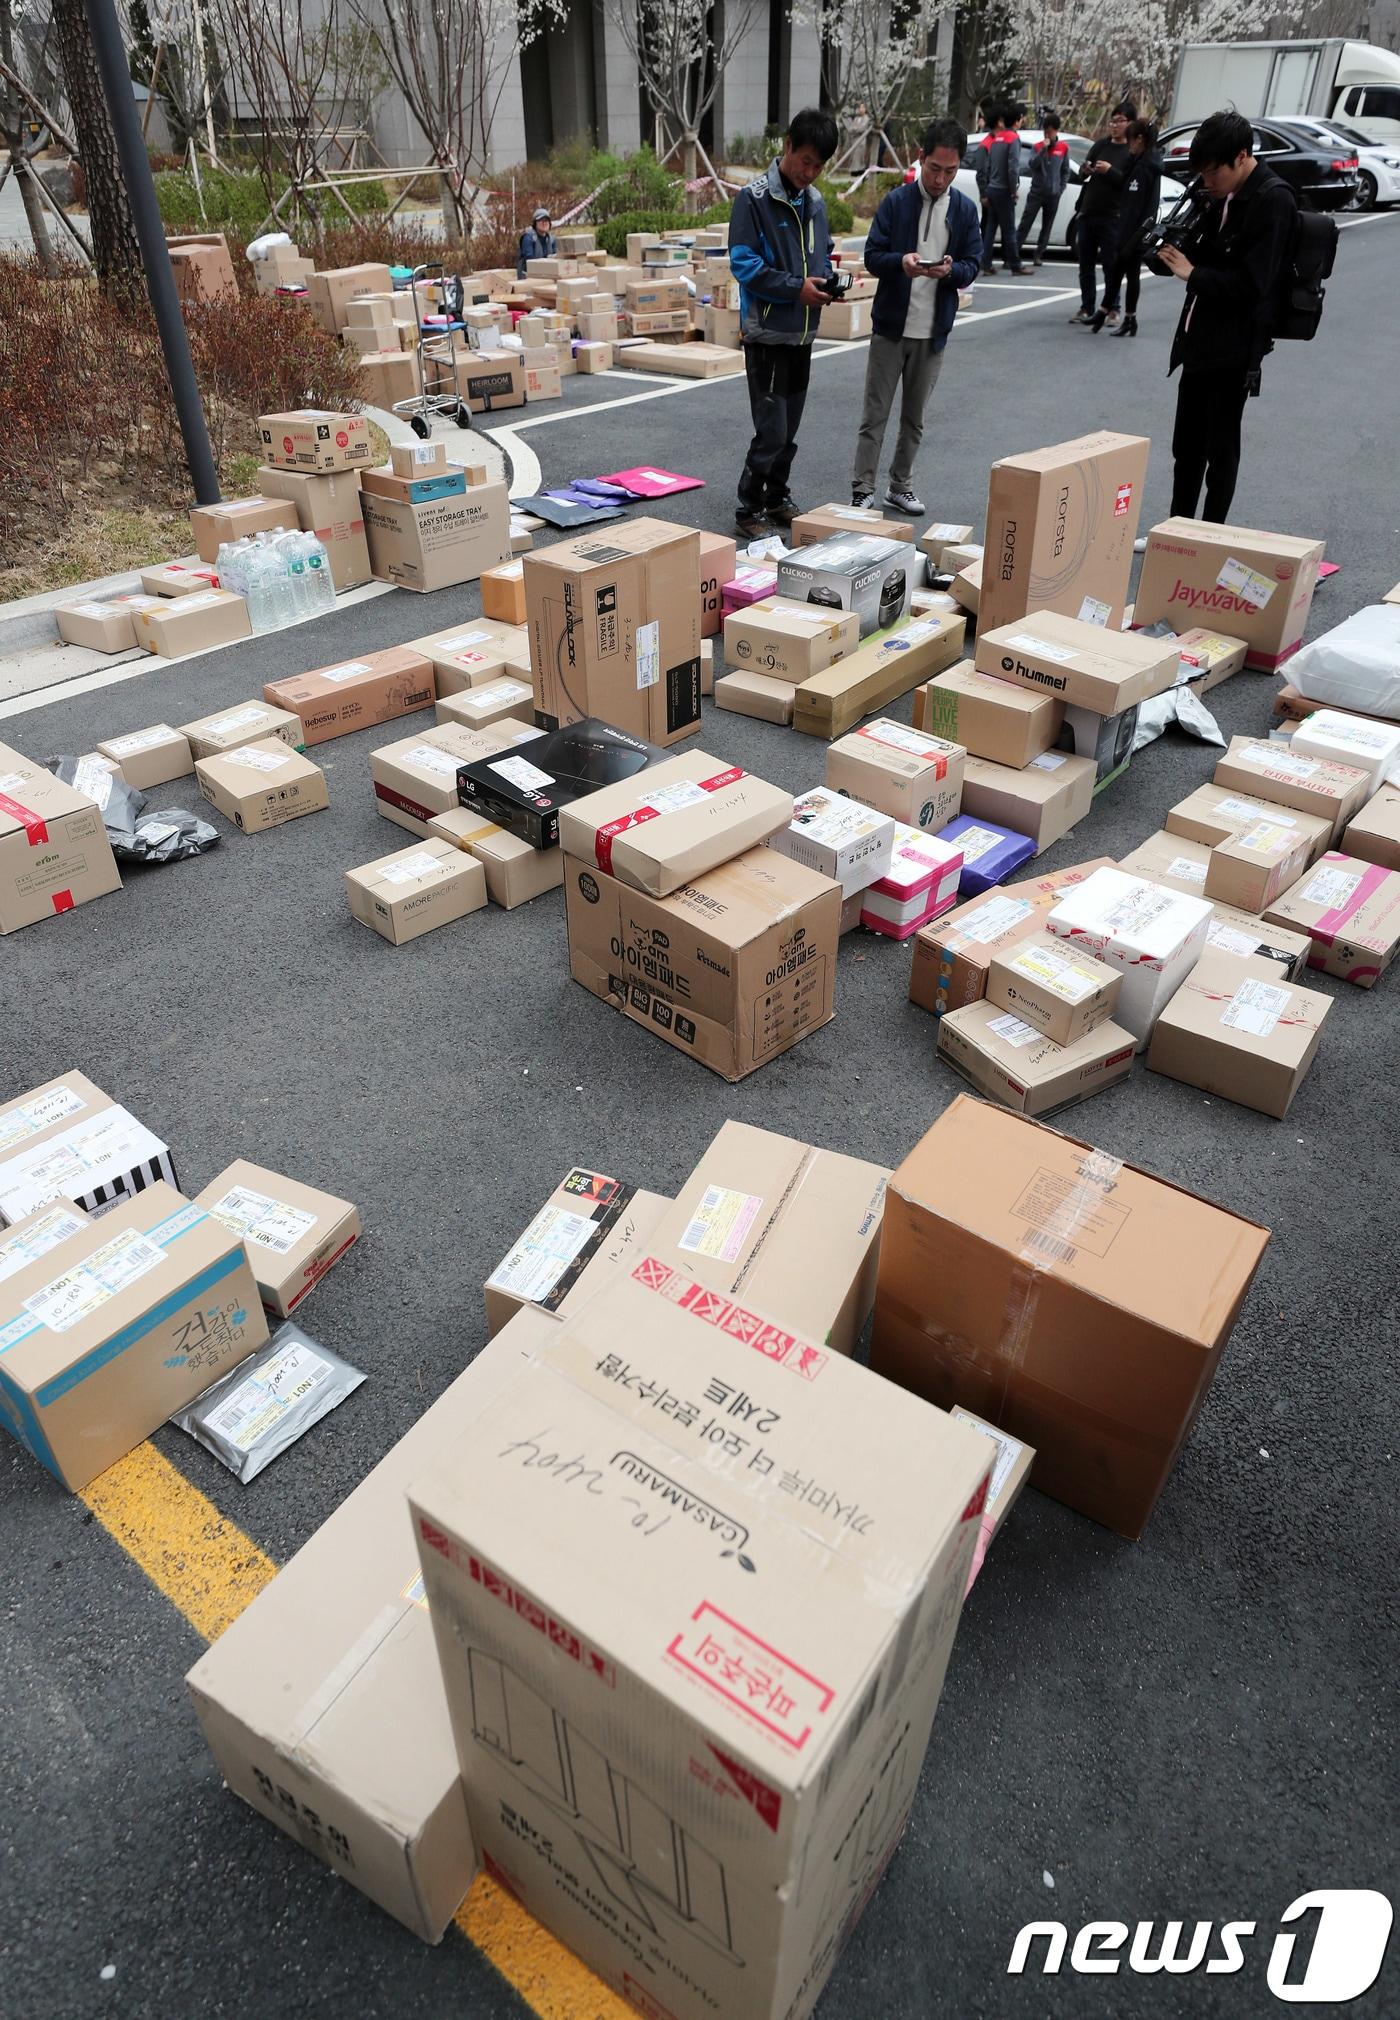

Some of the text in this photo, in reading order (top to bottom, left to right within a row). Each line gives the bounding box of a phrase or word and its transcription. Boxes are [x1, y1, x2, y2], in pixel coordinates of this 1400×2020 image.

[471, 376, 509, 389] HEIRLOOM
[419, 506, 483, 528] EASY STORAGE TRAY
[1053, 486, 1070, 559] norsta
[1001, 520, 1017, 581] norsta
[781, 566, 814, 581] CUCKOO
[854, 569, 881, 591] CUCKOO
[1168, 579, 1258, 616] Jaywave
[599, 617, 608, 654] FRAGILE
[1016, 661, 1068, 691] hummel
[304, 712, 337, 729] Bebesup
[932, 705, 958, 725] LIVE
[466, 781, 475, 792] LG
[522, 789, 541, 803] LG
[549, 819, 557, 832] LG
[35, 853, 60, 867] erom
[403, 882, 459, 912] AMOREPACIFIC
[653, 933, 668, 947] PAD
[610, 936, 692, 999] 아이엠패드
[696, 948, 731, 979] Petmade
[765, 943, 817, 987] 아이엠패드
[634, 989, 648, 1006] BIG
[1018, 994, 1053, 1018] NeoPharm
[654, 1004, 671, 1021] 100
[856, 1212, 877, 1238] Amway
[703, 1375, 782, 1435] 2세트
[595, 1356, 875, 1538] 까사마루 더 모아 분리수거함
[618, 1457, 740, 1546] CASAMARU
[694, 1633, 799, 1721] 파손주의
